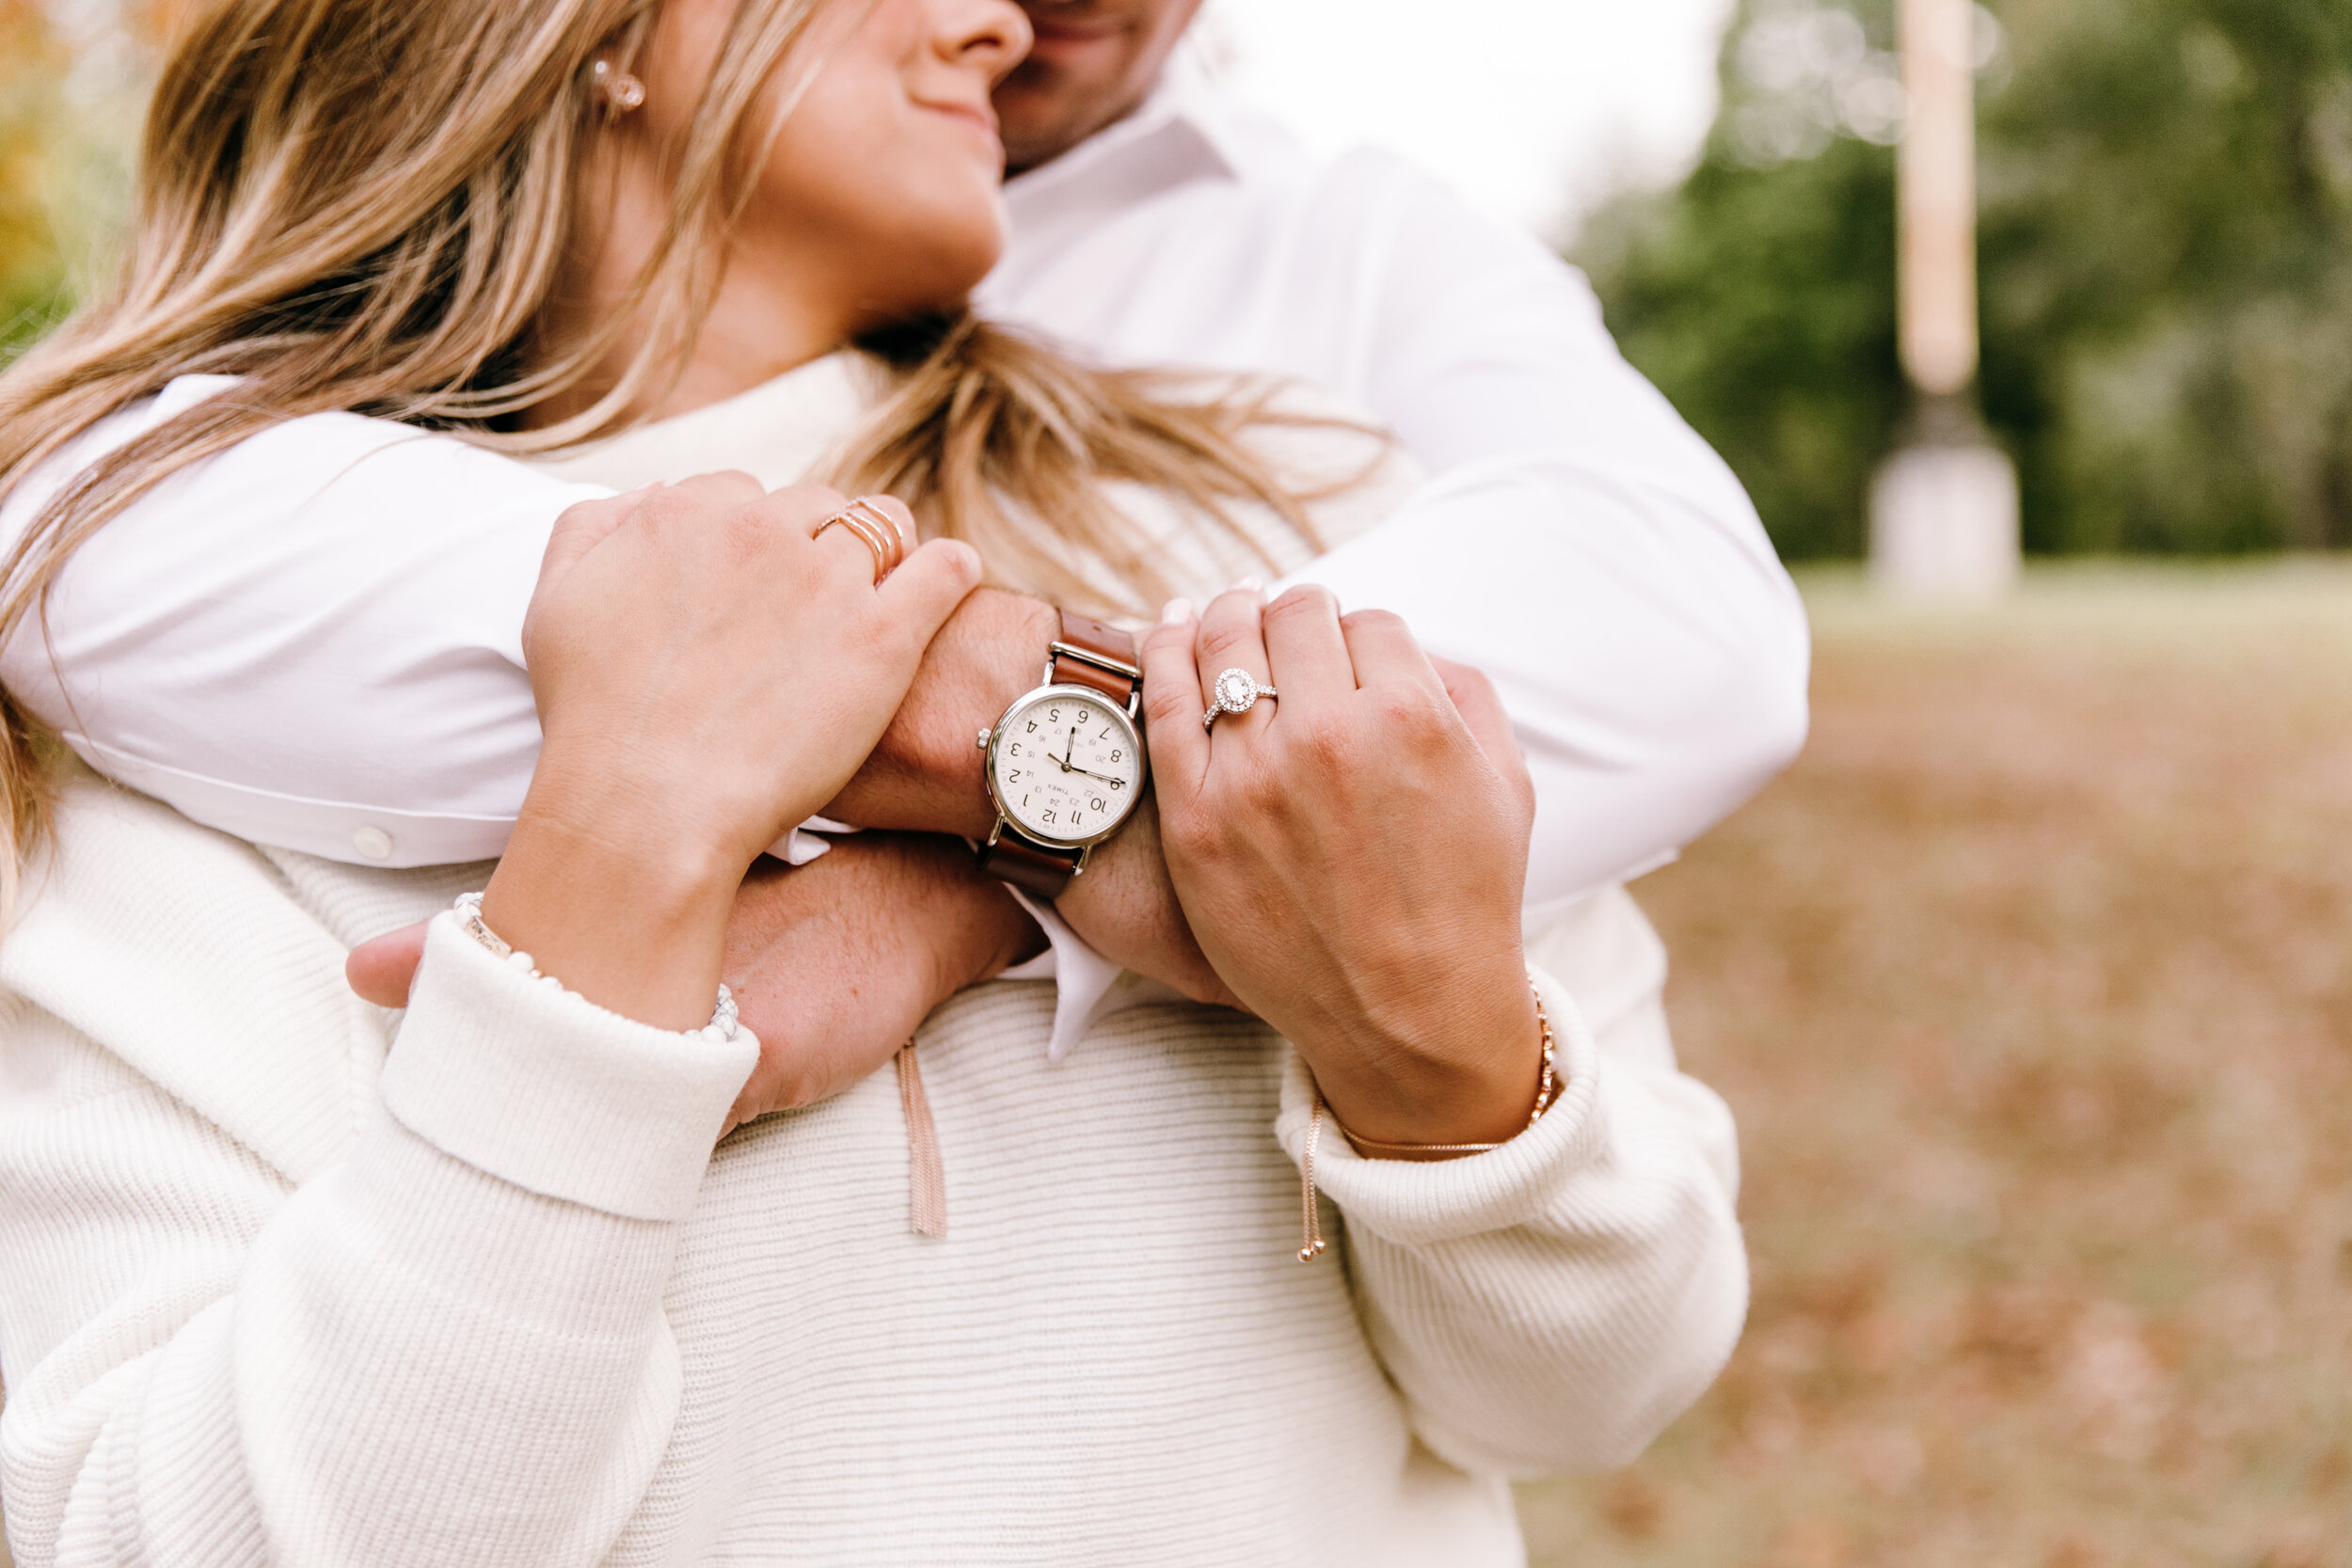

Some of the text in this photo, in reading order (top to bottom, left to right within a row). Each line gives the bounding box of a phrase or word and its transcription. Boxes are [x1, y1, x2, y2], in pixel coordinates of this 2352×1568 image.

[1048, 708, 1060, 723] 5
[1077, 710, 1089, 723] 6
[1026, 720, 1038, 734] 4
[1099, 727, 1110, 740] 7
[1039, 735, 1046, 743] 16
[1010, 742, 1022, 757] 3
[1027, 751, 1036, 759] 15
[1110, 749, 1121, 763] 8
[1095, 754, 1106, 764] 20
[1009, 768, 1021, 784] 2
[1035, 785, 1042, 794] 13
[1048, 784, 1069, 797] TIMEX
[1084, 789, 1094, 799] 22
[1023, 794, 1028, 807] 1
[1049, 798, 1060, 807] 24
[1069, 797, 1080, 807] 23
[1090, 798, 1106, 814] 10
[1041, 809, 1057, 824] 12
[1071, 810, 1082, 825] 11
